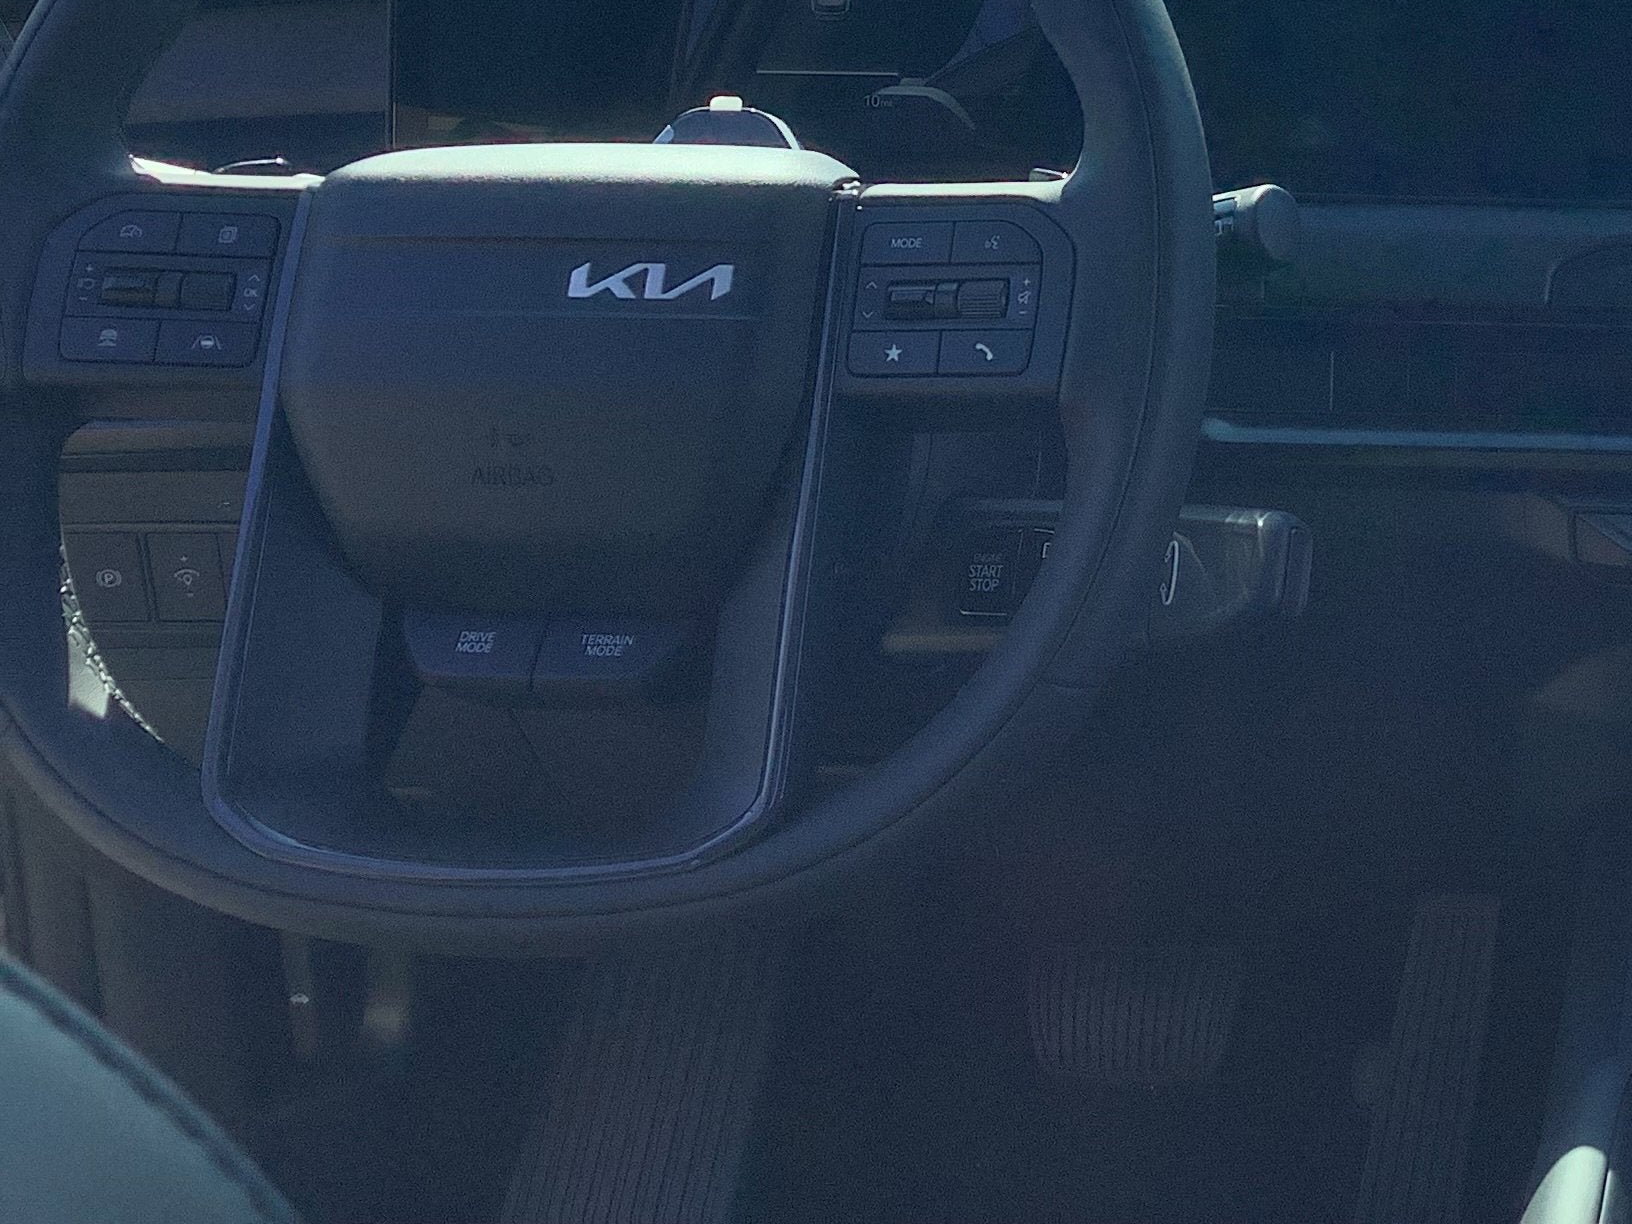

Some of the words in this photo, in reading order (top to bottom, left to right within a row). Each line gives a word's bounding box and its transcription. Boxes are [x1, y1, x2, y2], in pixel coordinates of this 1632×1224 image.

[890, 237, 923, 249] MODE
[567, 261, 735, 302] KIA
[968, 564, 1004, 578] START
[968, 578, 1000, 592] STOP
[459, 631, 497, 643] DRIVE
[580, 634, 635, 645] TERRAIN
[455, 642, 494, 653] MODE
[584, 645, 623, 657] MODE
